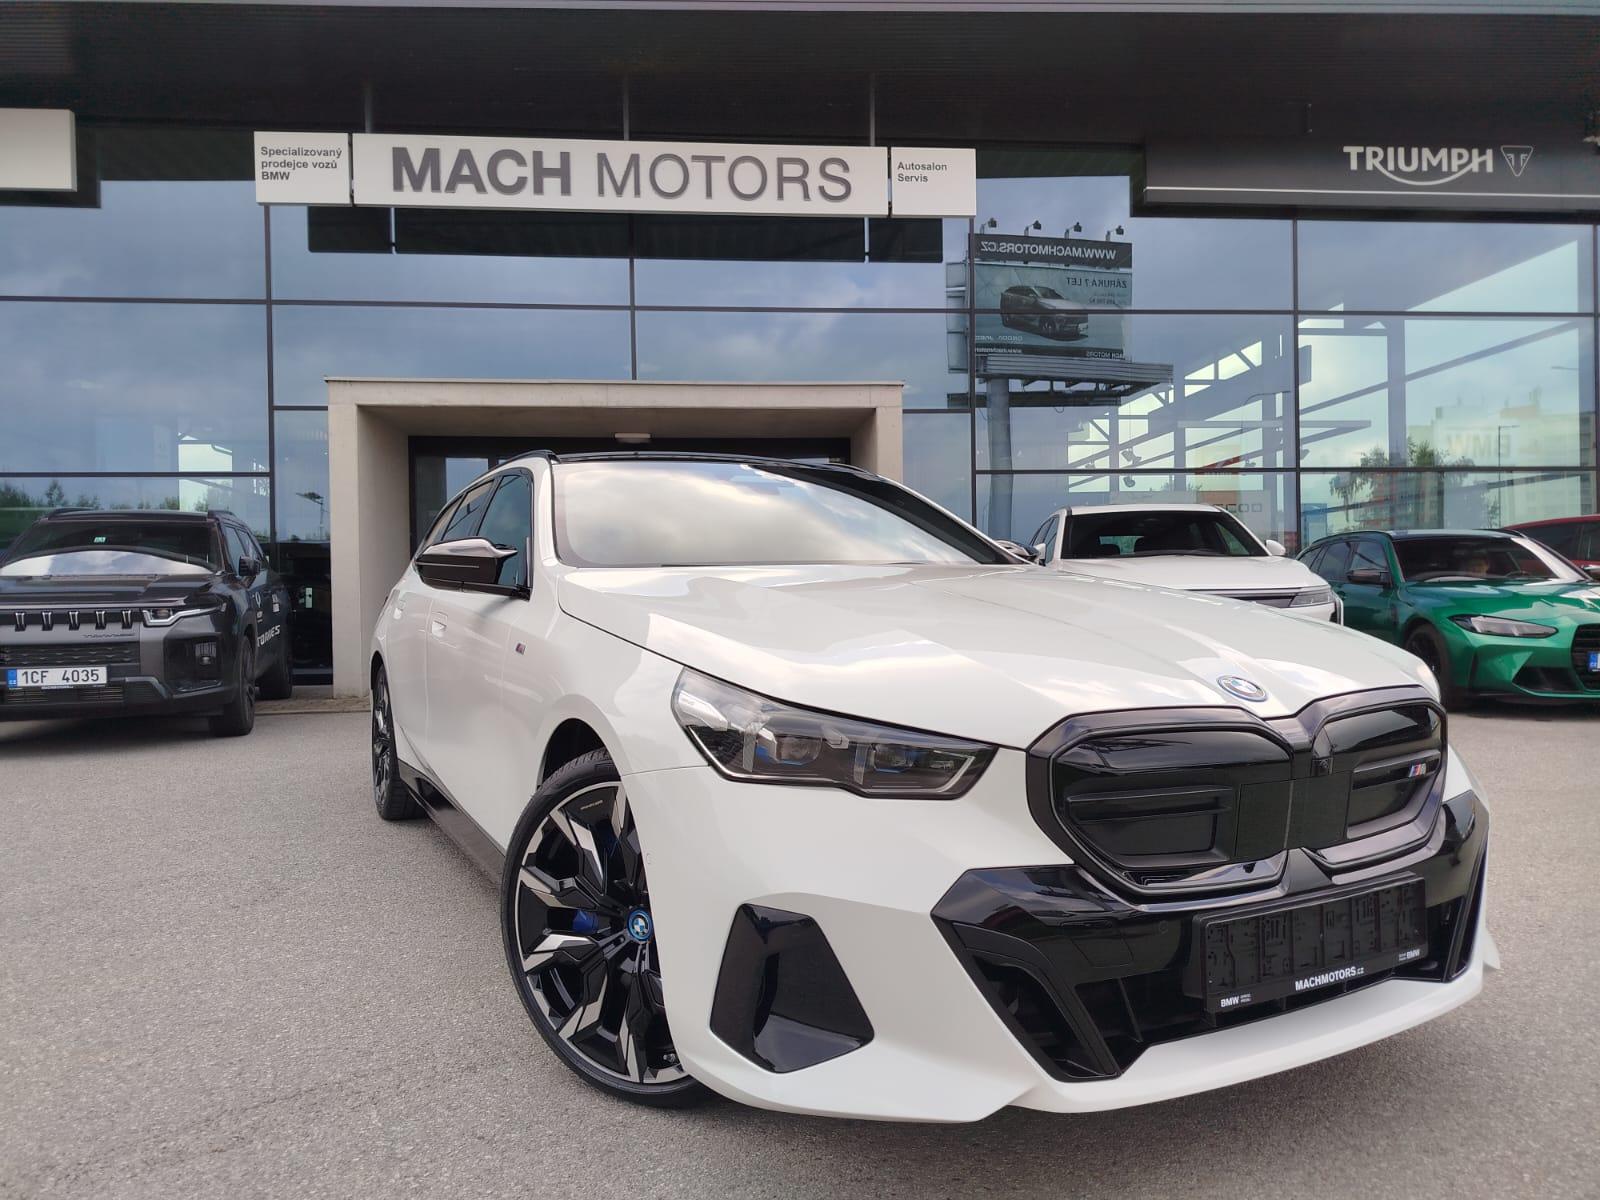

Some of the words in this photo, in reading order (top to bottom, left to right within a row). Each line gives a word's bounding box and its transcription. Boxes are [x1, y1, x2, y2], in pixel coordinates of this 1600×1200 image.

[260, 145, 343, 159] Specializovaný
[261, 158, 309, 171] prodejce
[311, 157, 338, 169] vozů
[897, 161, 948, 172] Autosalon
[1343, 145, 1494, 182] TRIUMPH
[261, 170, 290, 182] BMW
[392, 146, 572, 197] MACH
[596, 151, 852, 203] MOTORS
[897, 173, 929, 183] Servis
[21, 670, 49, 685] 1CF
[62, 668, 100, 684] 4035
[1220, 995, 1240, 1008] BMW
